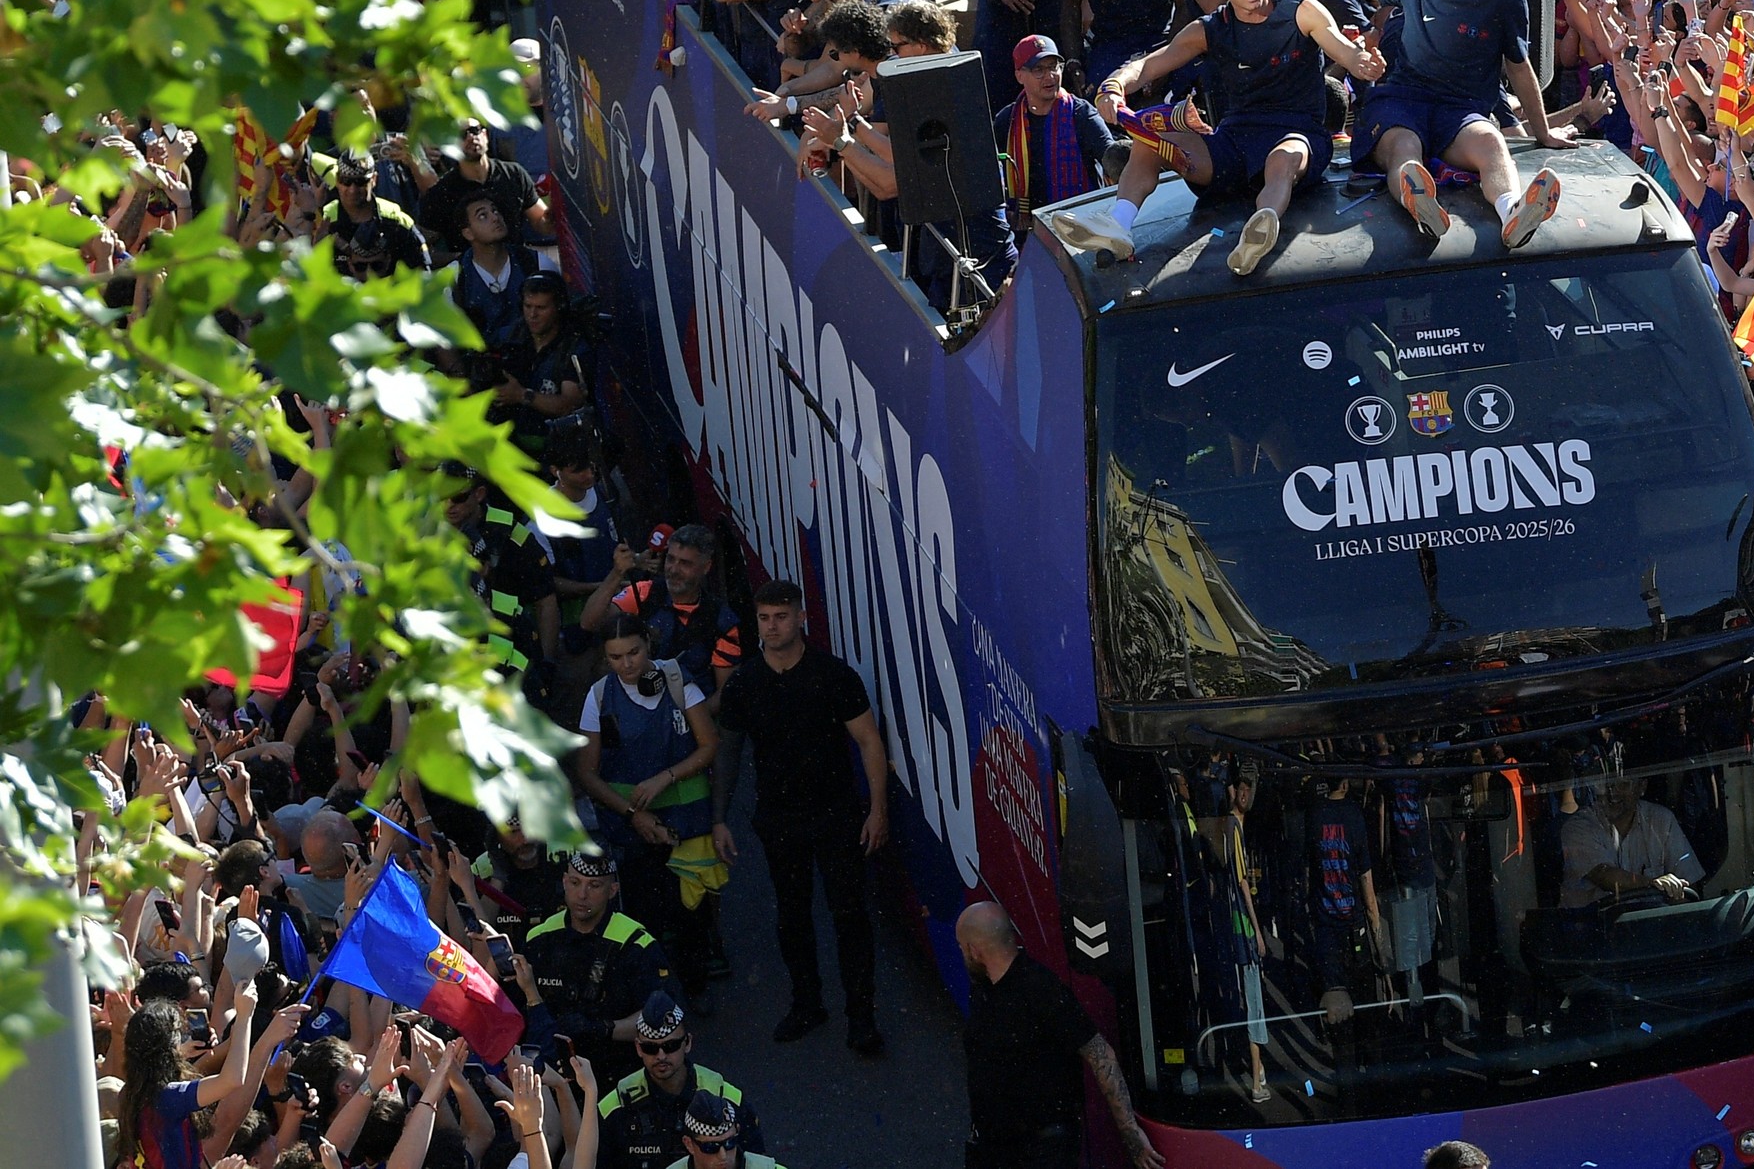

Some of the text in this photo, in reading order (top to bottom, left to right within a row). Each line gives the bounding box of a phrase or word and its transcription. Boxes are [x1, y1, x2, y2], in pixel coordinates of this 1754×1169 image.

[1416, 327, 1461, 341] PHILIPS
[1574, 321, 1654, 336] CUPRA
[1398, 342, 1485, 360] AMBILIGHT tv
[643, 85, 980, 890] CAMPIONS
[1282, 439, 1596, 531] CAMPIONS
[650, 531, 665, 547] S
[1314, 517, 1576, 561] LLIGA I SUPERCOPA 2025/26
[972, 615, 1038, 733] UNA MANERA
[990, 682, 1027, 763] DE SER
[979, 711, 1045, 831] UNA MANERA
[984, 761, 1000, 812] DE
[496, 915, 522, 924] OLICIA
[441, 957, 458, 969] FCB
[537, 977, 563, 987] POLICIA
[629, 1146, 662, 1154] POLICIA
